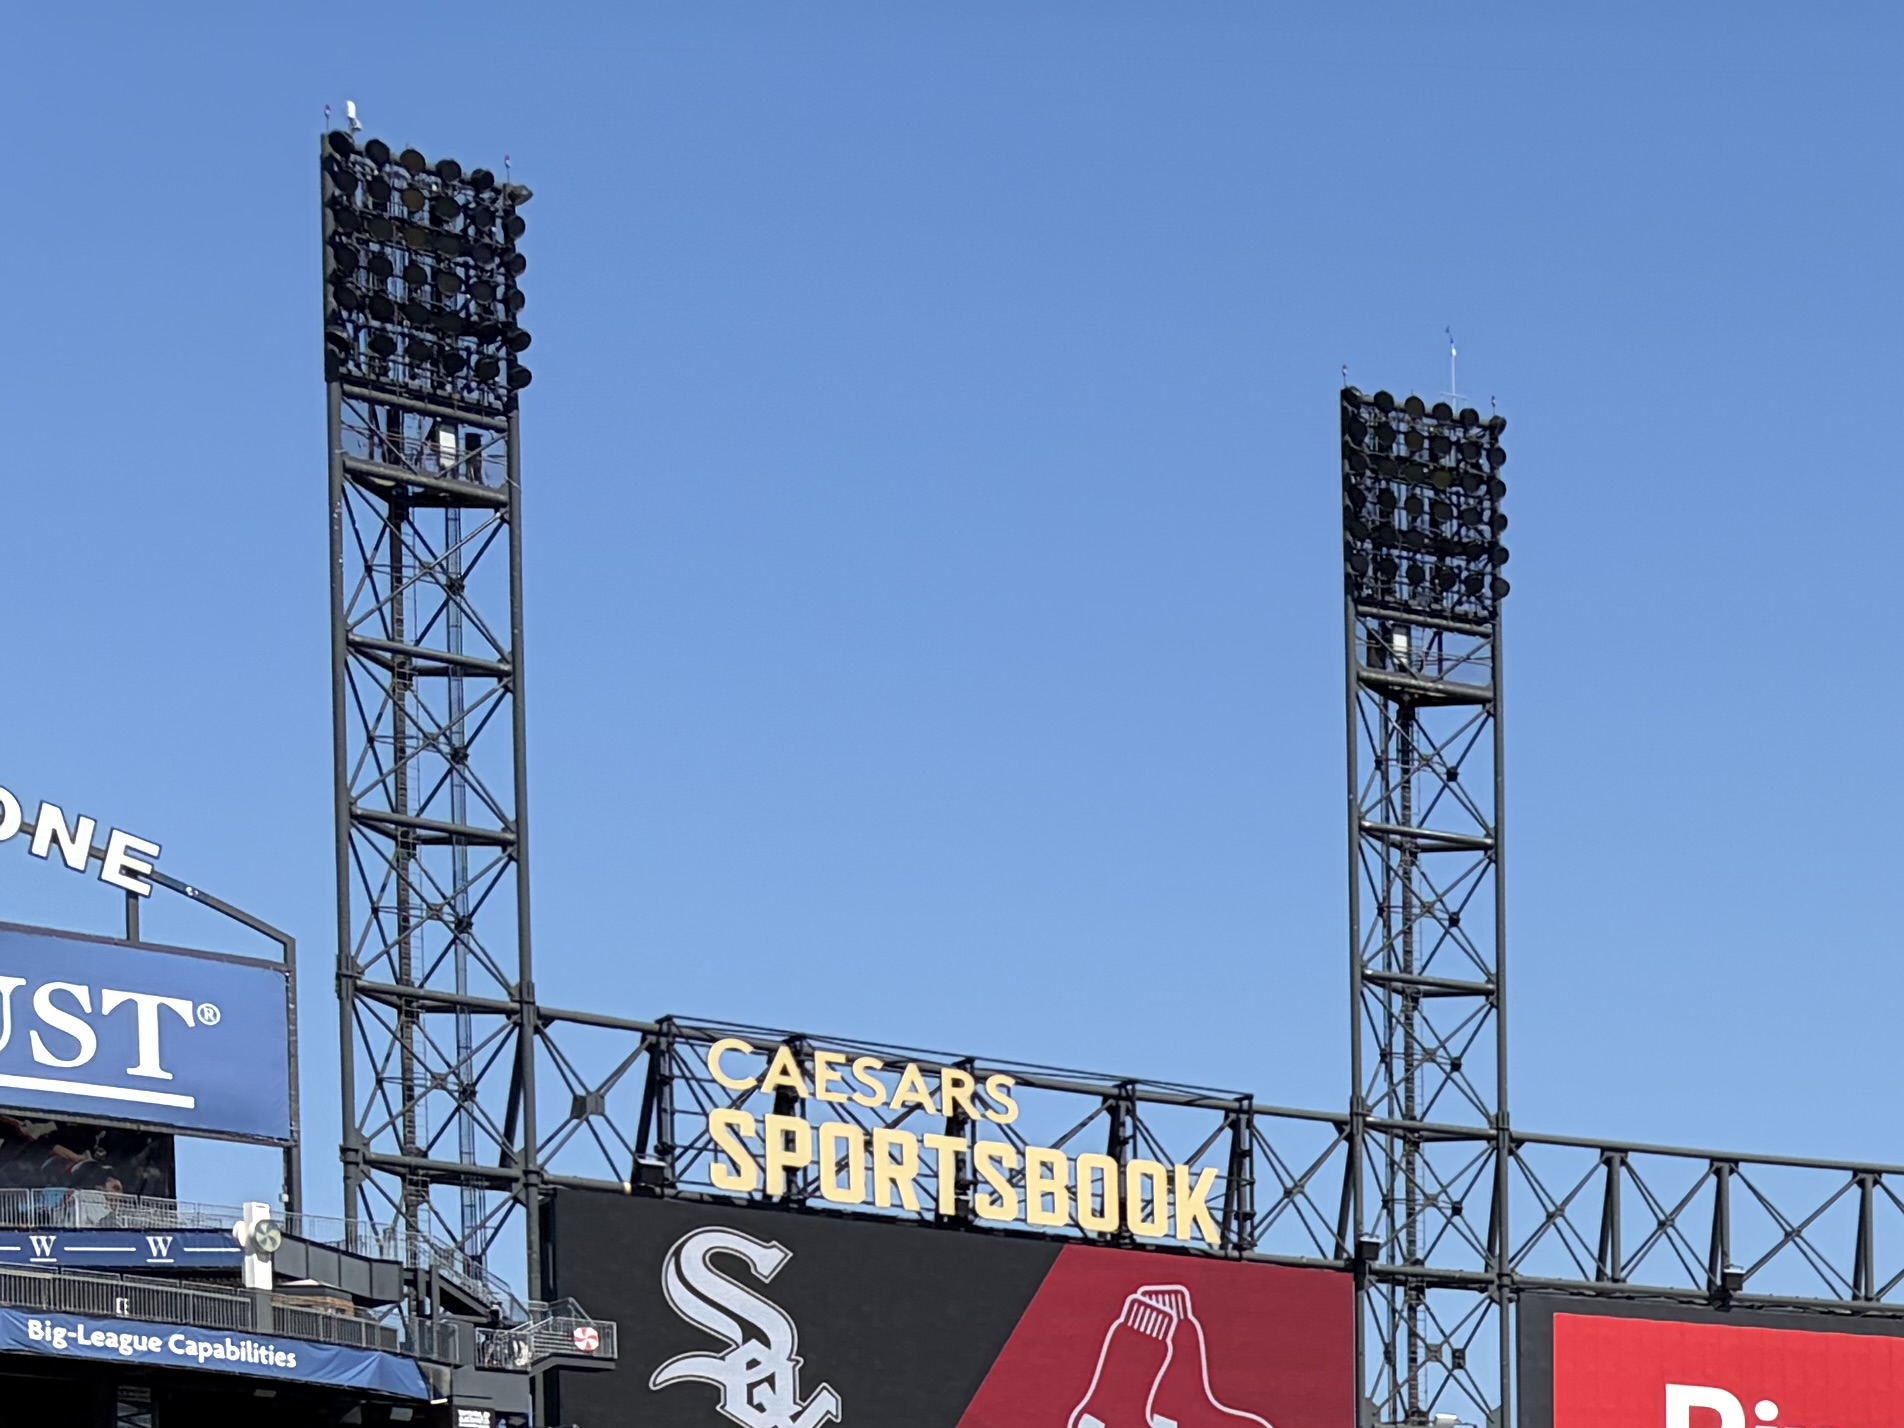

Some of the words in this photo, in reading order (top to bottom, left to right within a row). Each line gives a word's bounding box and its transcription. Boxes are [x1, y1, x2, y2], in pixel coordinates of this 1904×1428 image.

[706, 1038, 1020, 1124] CAESARS
[708, 1107, 1222, 1245] SPORTSBOOK
[29, 1236, 56, 1257] W
[146, 1237, 173, 1257] W
[27, 1319, 162, 1356] Big-League
[168, 1333, 297, 1368] Capabilities
